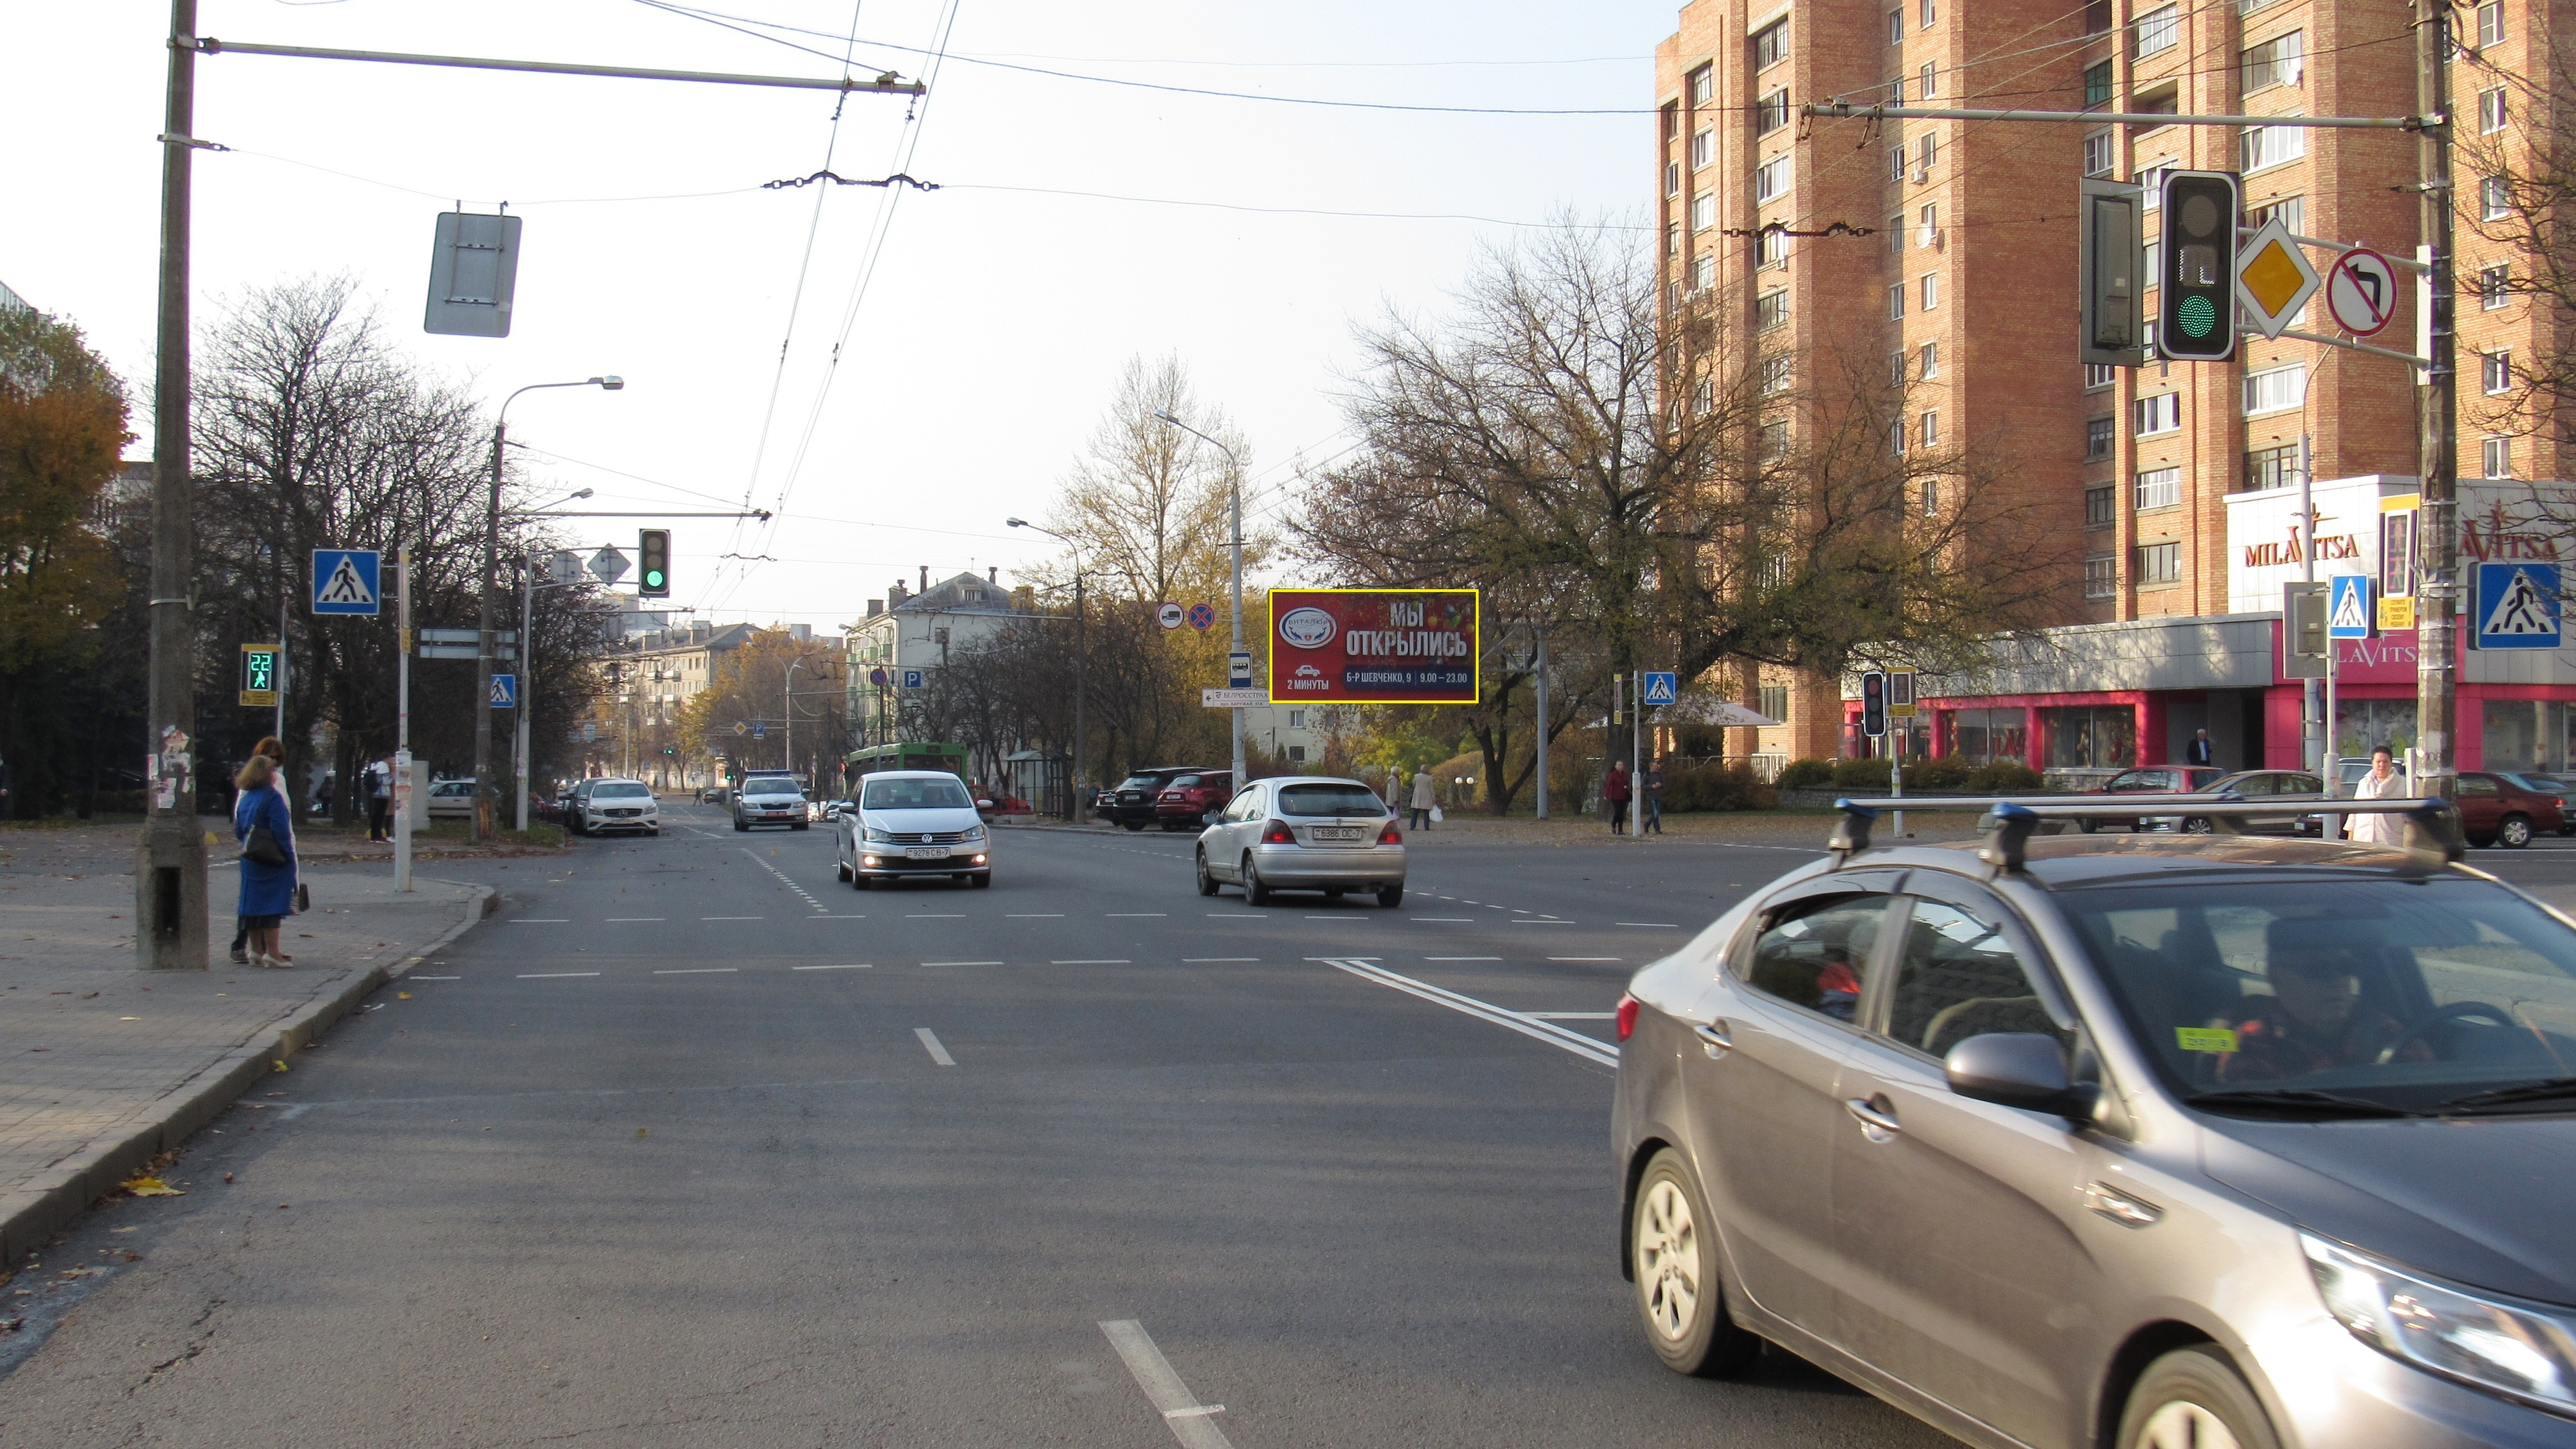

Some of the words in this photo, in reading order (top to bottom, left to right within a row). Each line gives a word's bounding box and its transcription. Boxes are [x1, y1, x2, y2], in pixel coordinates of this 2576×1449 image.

[1390, 603, 1423, 627] МЫ
[1347, 631, 1467, 656] ОТКРЫЛИСЬ
[2337, 638, 2417, 667] LAVITS
[251, 655, 271, 671] 22
[908, 673, 918, 685] P
[1287, 680, 1293, 690] 2
[1294, 680, 1329, 690] МИНУТЫ
[1346, 673, 1360, 682] Б-Р
[1361, 673, 1405, 684] ШЕВЧЕНКО,
[1407, 673, 1412, 683] 9
[1420, 673, 1437, 683] 9.00
[1446, 673, 1467, 683] 23.00
